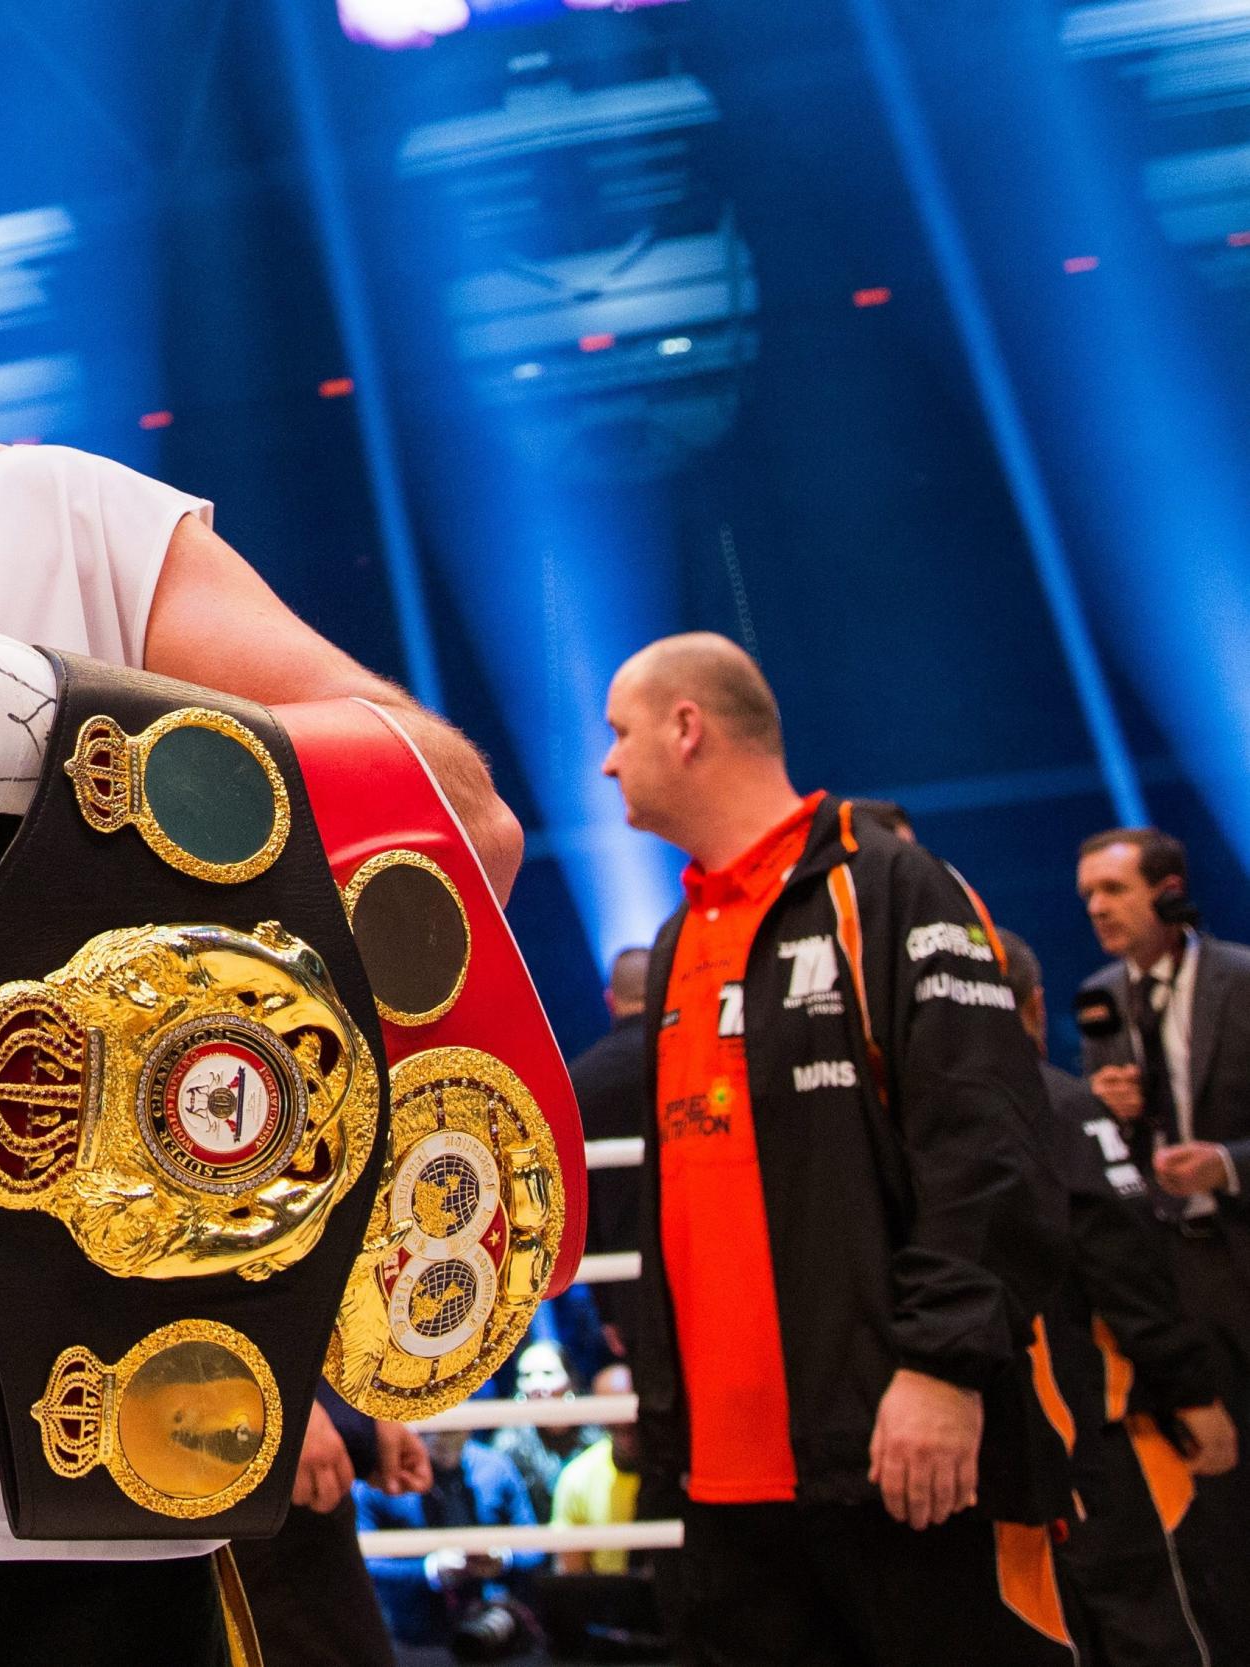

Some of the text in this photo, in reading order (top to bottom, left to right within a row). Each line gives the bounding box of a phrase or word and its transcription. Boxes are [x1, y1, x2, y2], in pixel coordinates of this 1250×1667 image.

[152, 1028, 227, 1178] SUPER CHAMPION
[166, 1050, 200, 1151] WORLD BOXING
[256, 1065, 280, 1150] ASSOCIATION
[383, 1248, 400, 1281] IB
